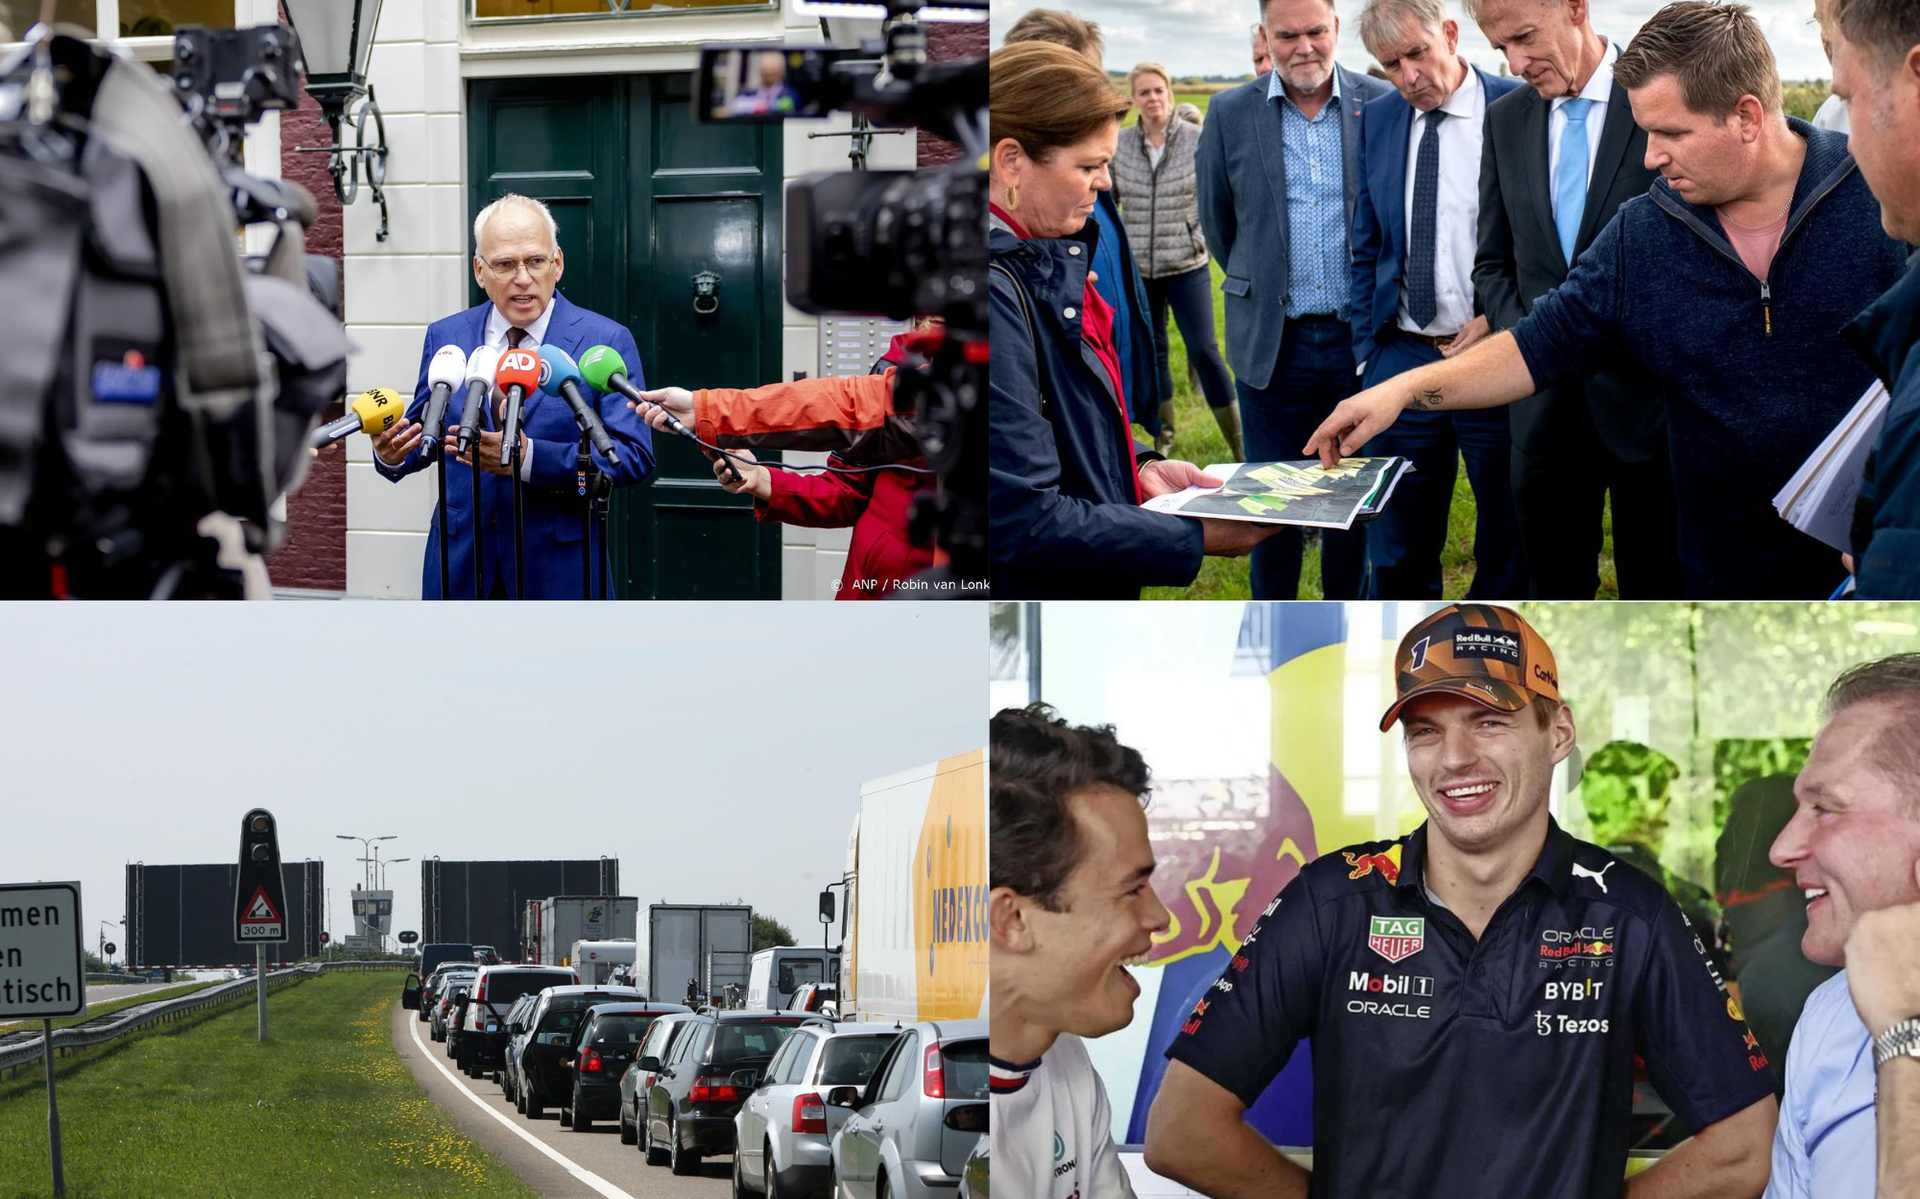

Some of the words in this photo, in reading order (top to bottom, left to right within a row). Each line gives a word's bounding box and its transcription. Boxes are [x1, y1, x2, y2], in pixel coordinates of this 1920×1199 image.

[500, 353, 536, 371] AD
[1456, 633, 1474, 643] Red
[1474, 634, 1491, 643] Bull
[1411, 636, 1430, 672] 1
[1456, 645, 1518, 657] RACING
[932, 883, 990, 943] NEDEXCO
[244, 926, 265, 935] 300
[1376, 920, 1420, 934] TAG
[1542, 926, 1614, 943] ORACLE
[1371, 936, 1420, 959] HEUER
[1540, 945, 1562, 957] Red
[1562, 942, 1581, 956] Bull
[1539, 959, 1613, 969] RACING
[1349, 971, 1410, 994] Mobil
[1545, 978, 1603, 1000] BYBIT
[1347, 1000, 1431, 1018] ORACLE
[1557, 1015, 1609, 1033] Tezos
